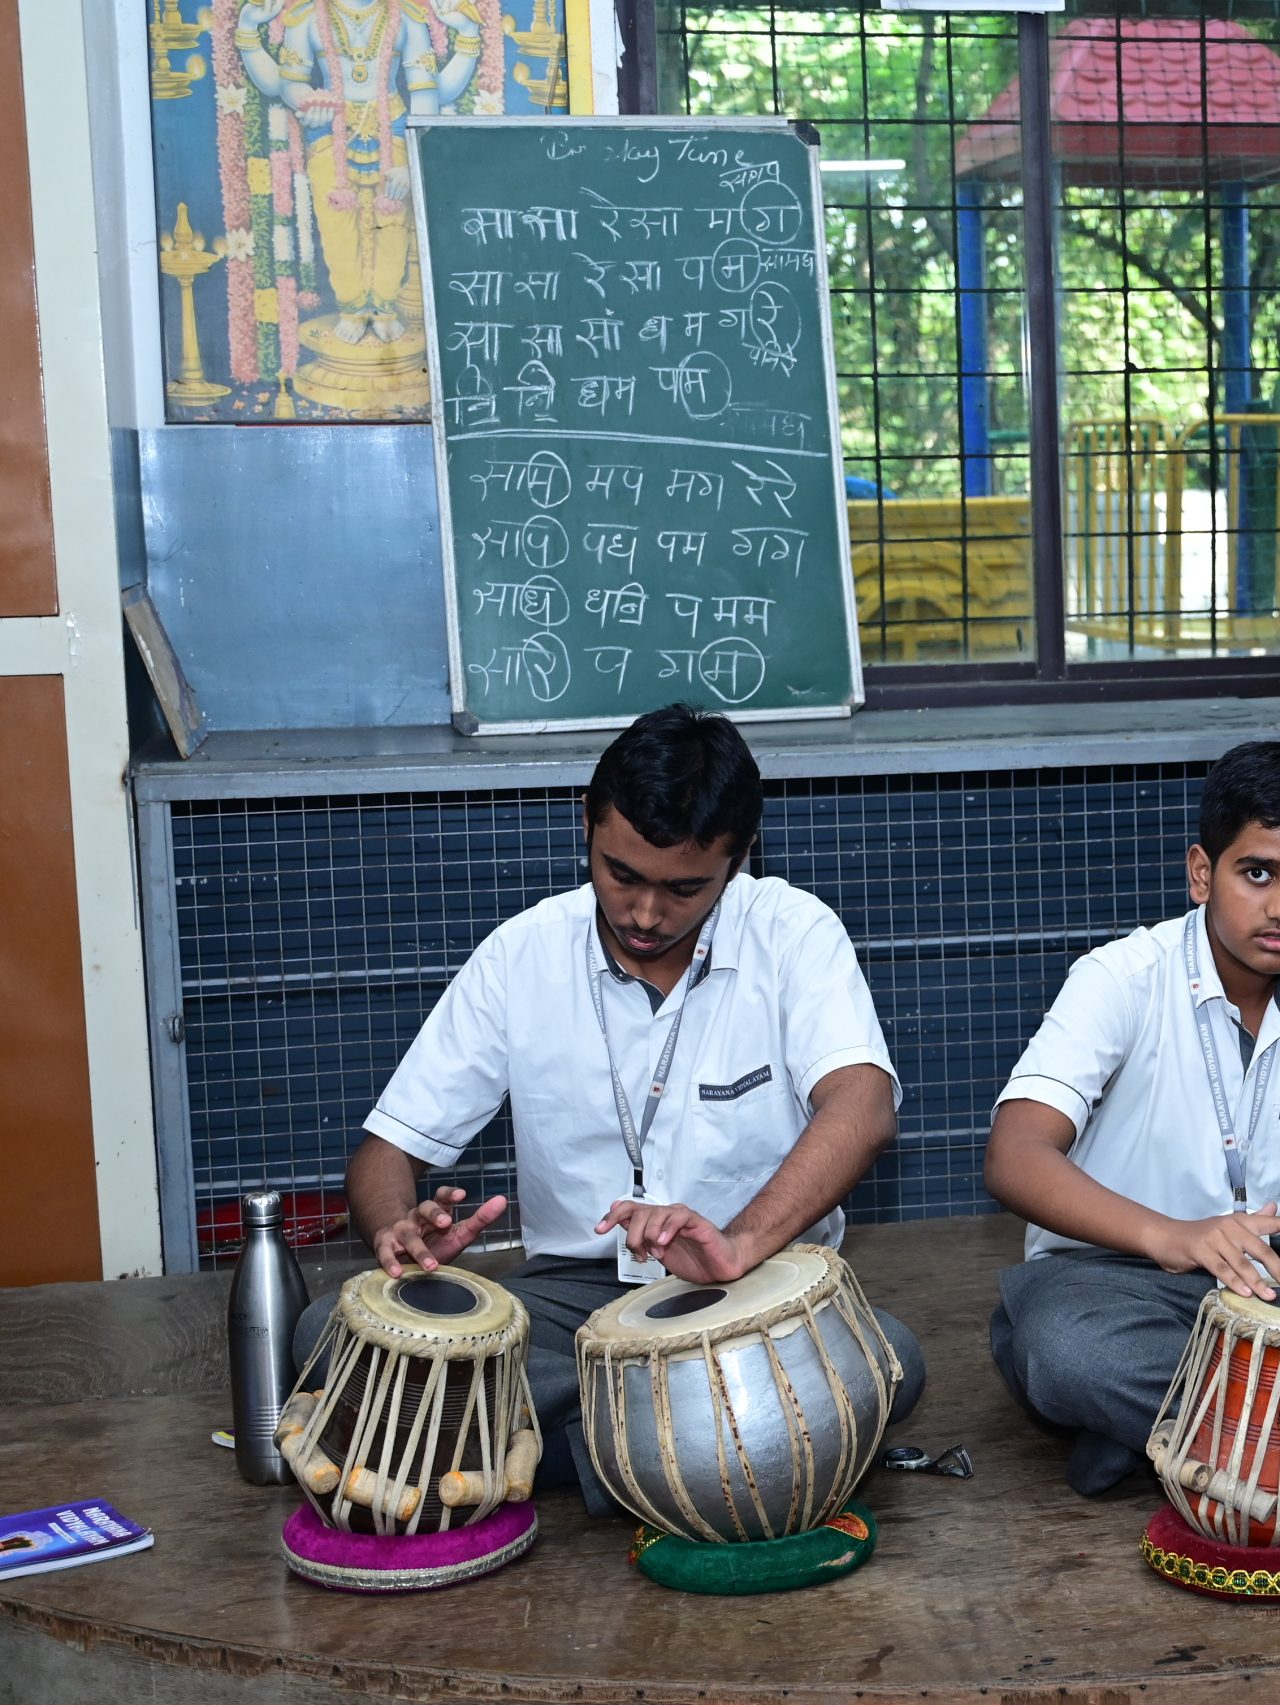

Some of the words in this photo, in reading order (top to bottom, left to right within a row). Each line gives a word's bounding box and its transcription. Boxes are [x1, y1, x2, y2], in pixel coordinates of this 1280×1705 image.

[657, 1031, 676, 1079] NARAYANA
[1200, 1023, 1218, 1080] VIDYALAYAM
[1258, 1045, 1274, 1086] VIDYALA
[1213, 1081, 1229, 1130] NARAYANA
[622, 1116, 640, 1163] NARAYANA
[82, 1506, 133, 1538] NARAYANA
